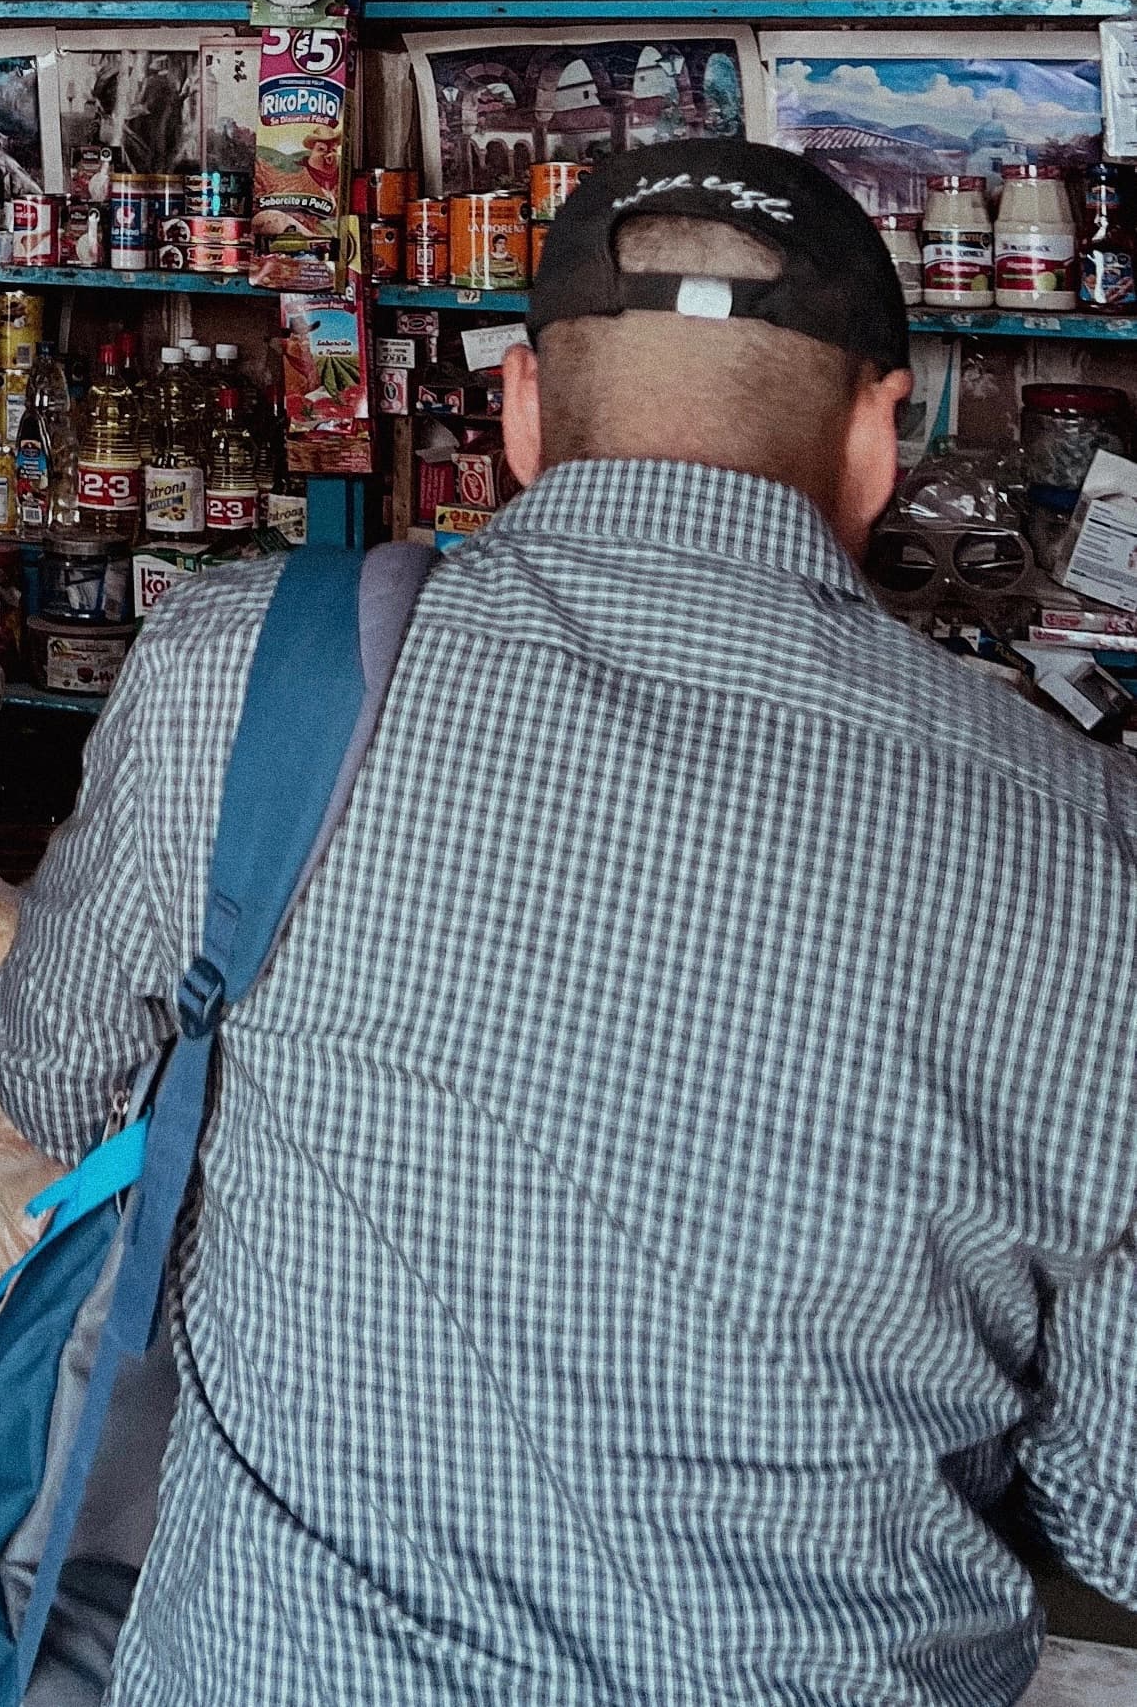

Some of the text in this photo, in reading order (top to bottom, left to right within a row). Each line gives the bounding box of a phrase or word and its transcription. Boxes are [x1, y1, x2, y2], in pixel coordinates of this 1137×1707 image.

[263, 89, 337, 116] RikoPollo
[259, 197, 300, 208] Saborcito
[309, 197, 332, 213] Pollo
[482, 223, 526, 233] MORENA
